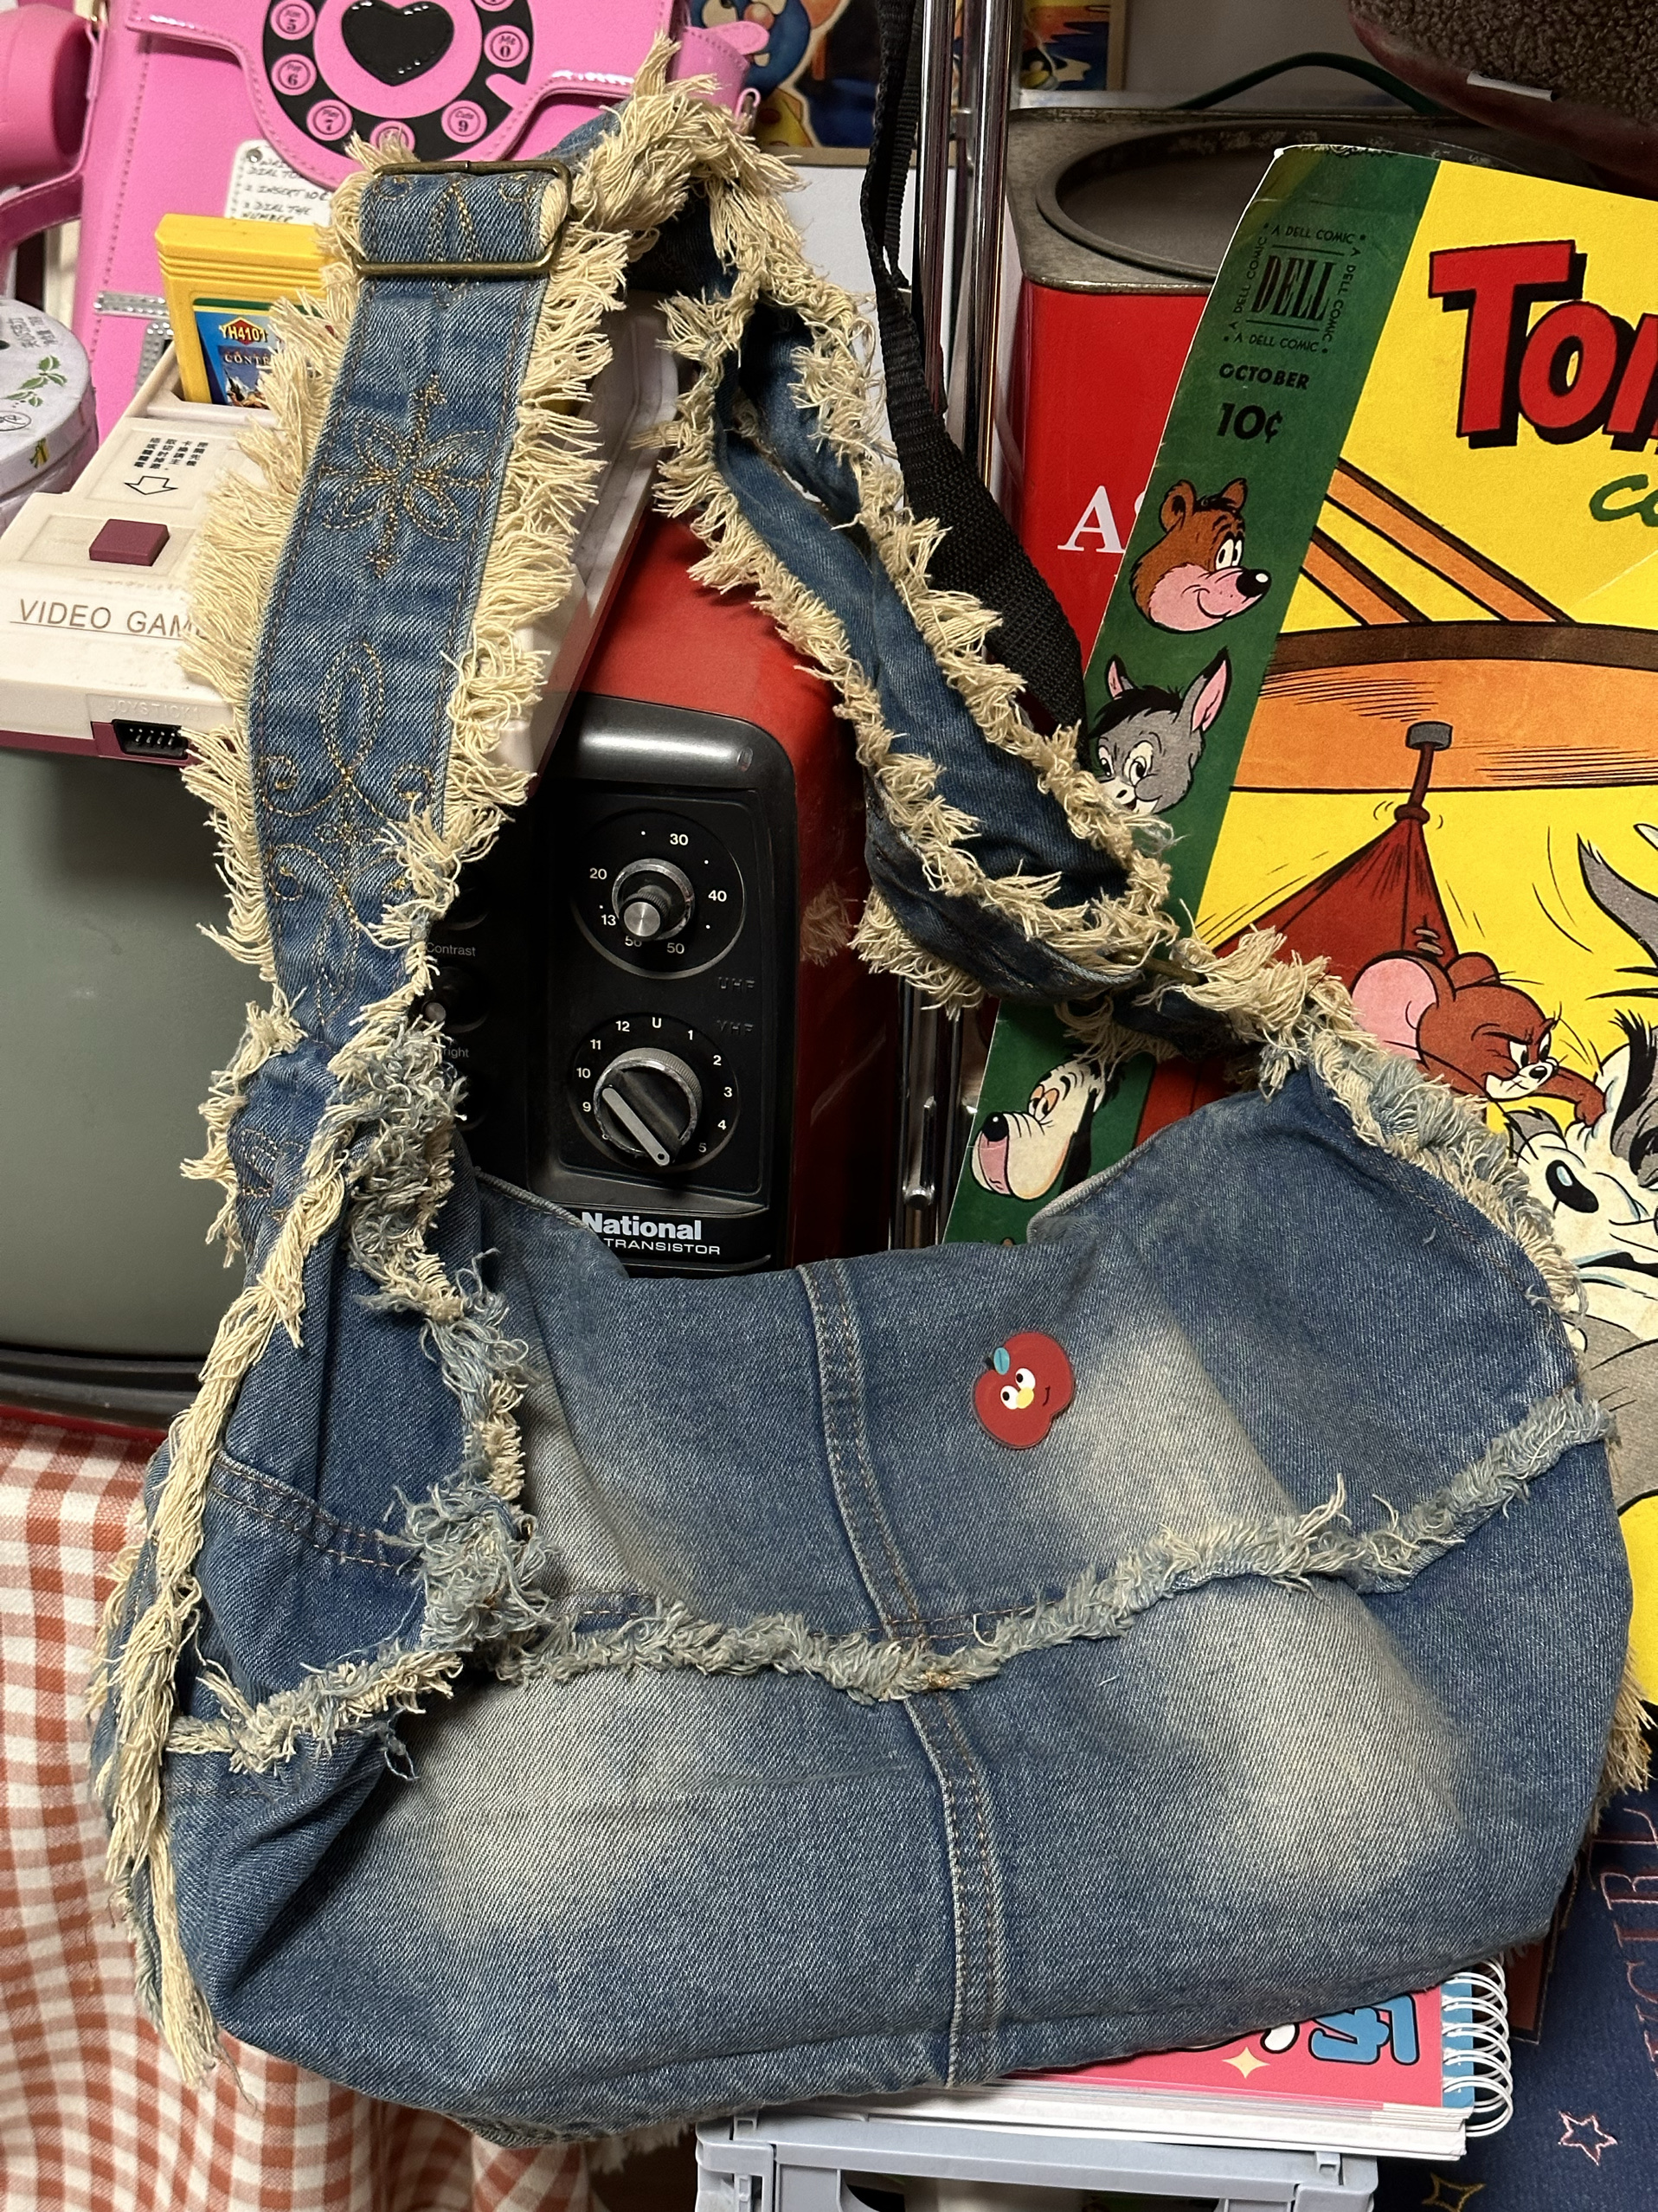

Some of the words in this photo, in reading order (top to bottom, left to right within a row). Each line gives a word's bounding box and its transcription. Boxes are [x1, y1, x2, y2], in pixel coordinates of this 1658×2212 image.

[499, 45, 511, 58] 0
[287, 74, 299, 86] 6
[324, 119, 334, 132] 7
[458, 119, 469, 132] 9
[1271, 225, 1281, 236] A
[1285, 226, 1312, 238] DELL
[1315, 229, 1355, 244] COMIC
[1350, 248, 1361, 257] A
[1228, 321, 1238, 330] A
[1233, 286, 1251, 314] DELL
[1246, 236, 1268, 279] COMIC
[1337, 264, 1356, 295] DELL
[1251, 255, 1337, 321] DELL
[1322, 299, 1345, 343] COMIC
[218, 324, 269, 344] YH4101
[1233, 332, 1244, 343] A
[1249, 334, 1276, 347] DELL
[1279, 338, 1320, 352] COMIC
[224, 350, 273, 366] CONTR
[1218, 363, 1310, 389] OCTOBER
[1216, 402, 1283, 443] 10¢
[21, 598, 112, 629] VIDEO
[670, 833, 689, 846] 30
[589, 867, 607, 880] 20
[708, 890, 728, 903] 40
[601, 914, 617, 926] 13
[426, 942, 477, 957] Contrast
[666, 942, 685, 955] 50
[717, 976, 755, 992] UHF
[615, 1020, 630, 1032] 12
[652, 1017, 662, 1029] U
[717, 1019, 755, 1037] VHF
[687, 1030, 694, 1041] 1
[590, 1038, 601, 1051] 11
[442, 1046, 470, 1058] right
[712, 1054, 722, 1066] 2
[576, 1067, 591, 1079] 10
[723, 1086, 733, 1097] 3
[582, 1101, 592, 1113] 9
[717, 1119, 727, 1130] 4
[698, 1142, 707, 1154] 5
[582, 1212, 702, 1241] National
[603, 1238, 721, 1255] TRANSISTOR
